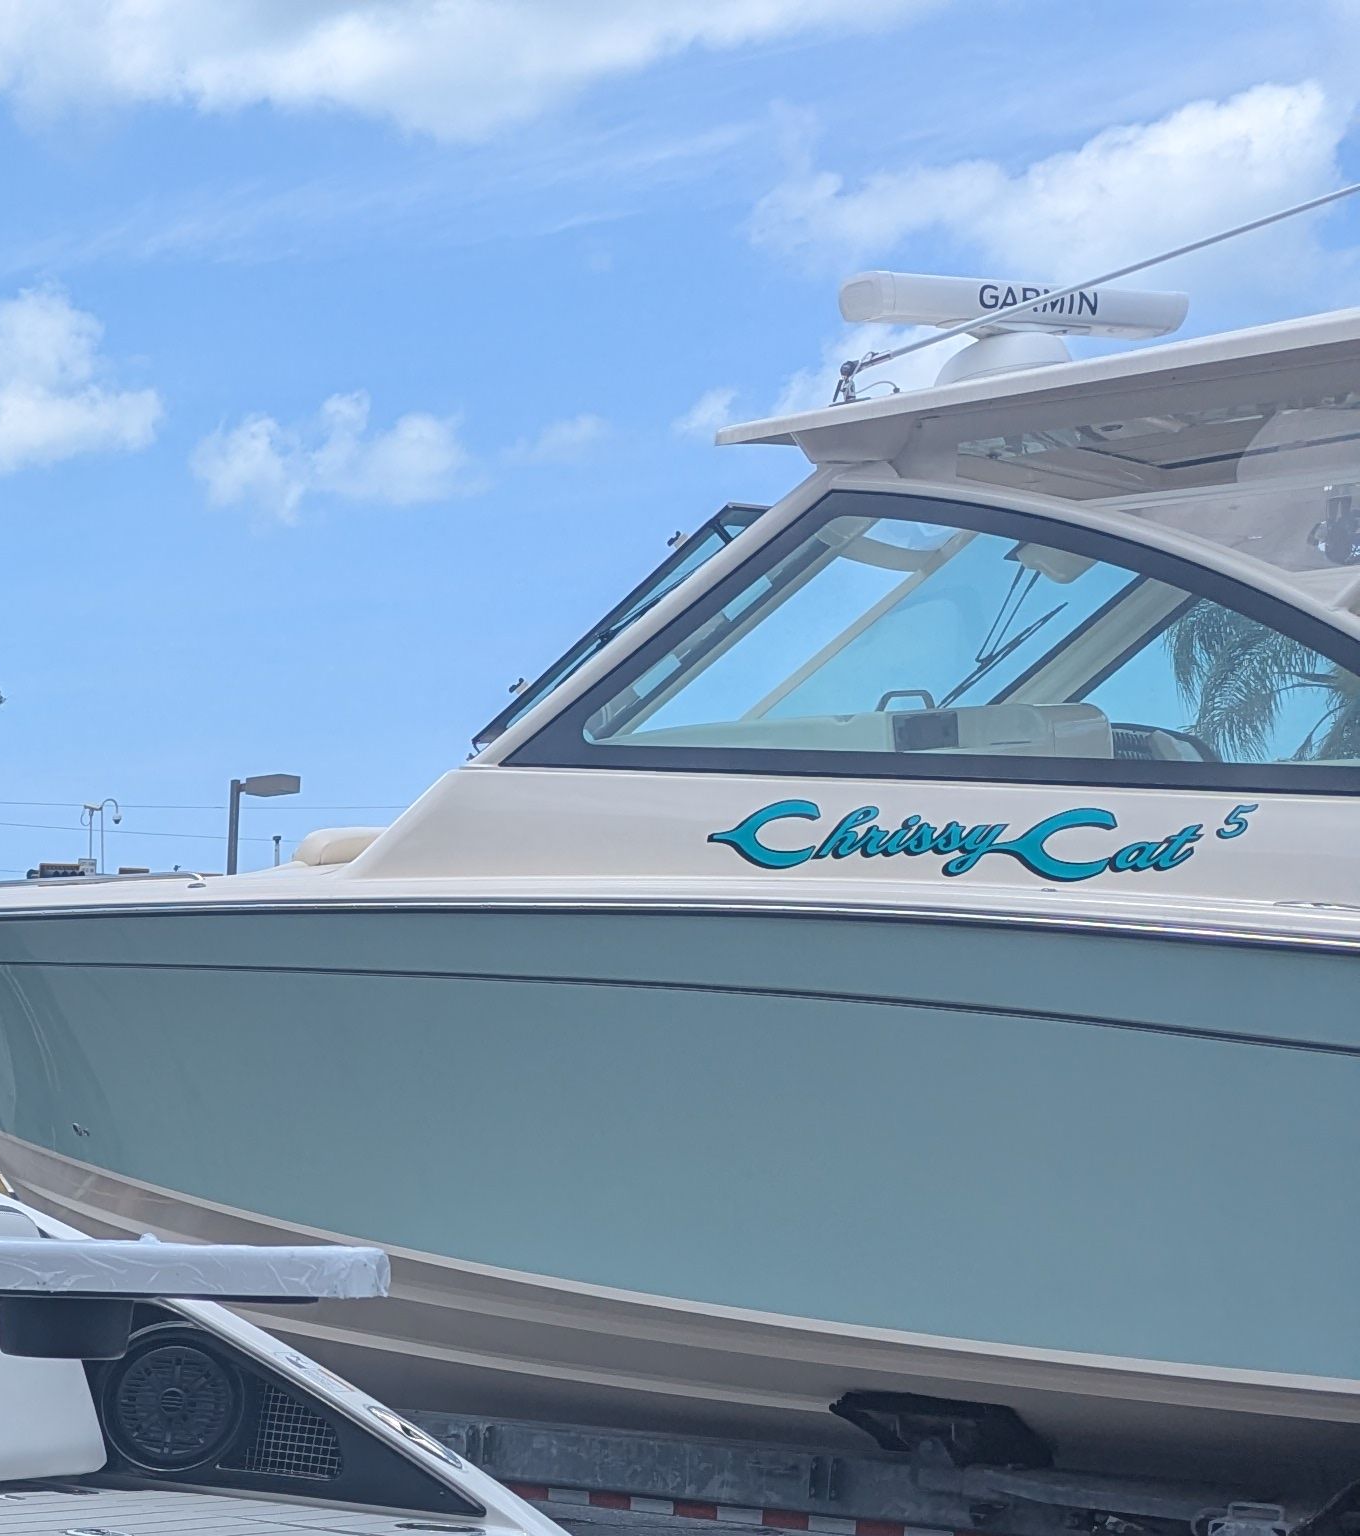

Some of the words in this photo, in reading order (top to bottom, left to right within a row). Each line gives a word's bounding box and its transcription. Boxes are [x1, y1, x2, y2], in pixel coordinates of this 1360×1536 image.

[978, 284, 1098, 316] GARMIN
[707, 799, 1009, 878] Chrissy
[981, 807, 1203, 883] Cat
[1216, 804, 1259, 839] 5
